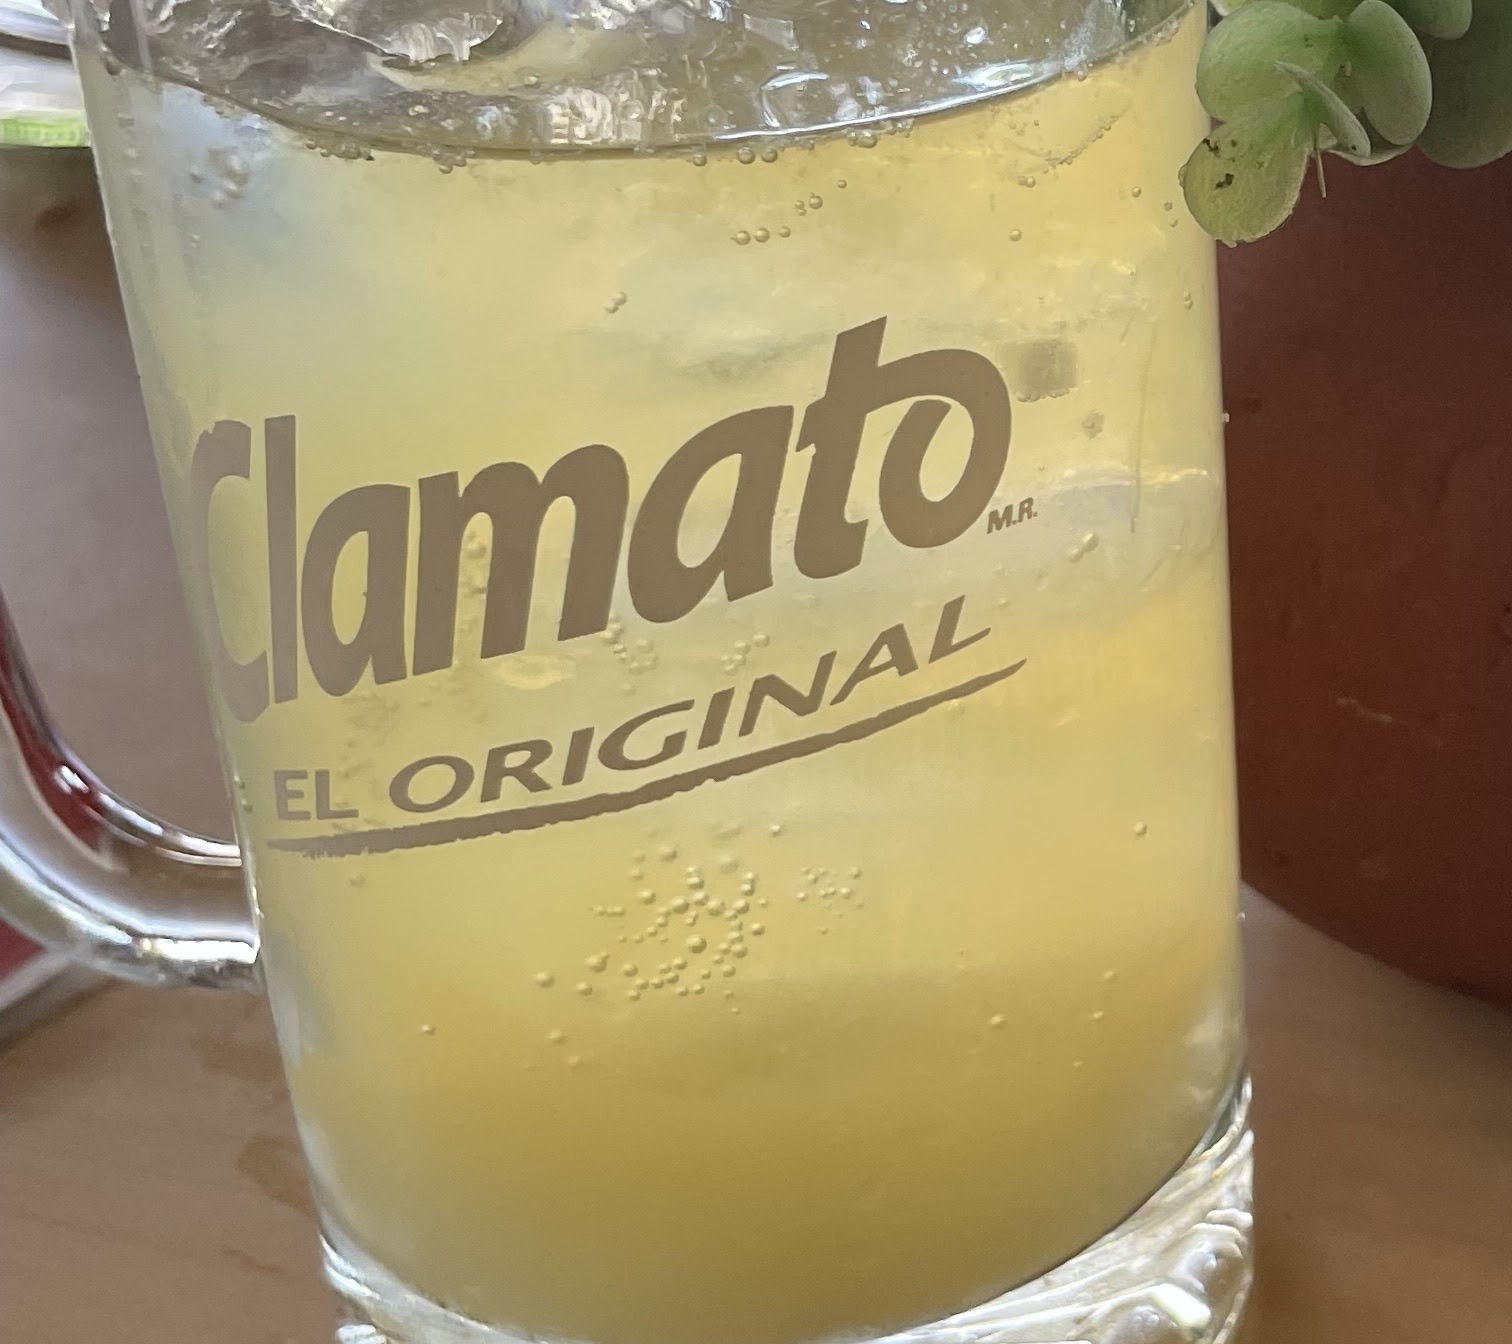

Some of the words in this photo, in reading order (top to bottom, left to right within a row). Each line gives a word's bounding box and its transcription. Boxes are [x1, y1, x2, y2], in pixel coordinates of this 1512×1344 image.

[191, 316, 1012, 722] Clamato
[987, 497, 1038, 534] M.R.
[274, 768, 360, 821] EL
[389, 594, 990, 813] ORIGINAL
